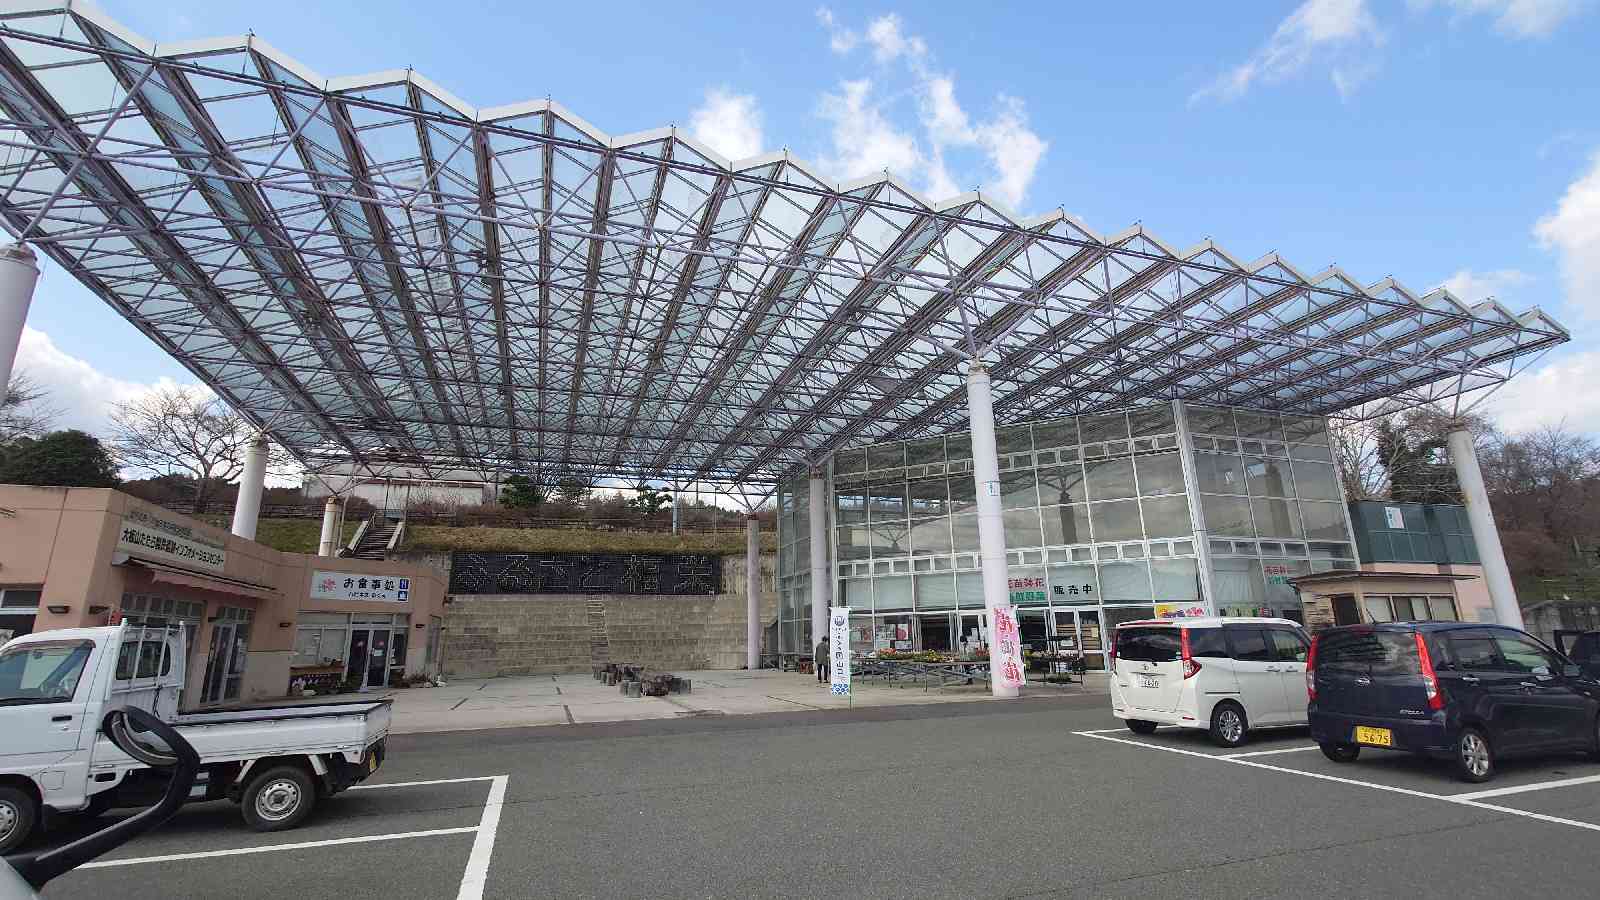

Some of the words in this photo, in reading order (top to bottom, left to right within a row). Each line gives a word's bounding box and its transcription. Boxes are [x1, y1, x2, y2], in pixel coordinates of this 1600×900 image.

[343, 577, 394, 592] お食事処
[1054, 583, 1093, 595] 販売中
[1363, 734, 1389, 744] 5675
